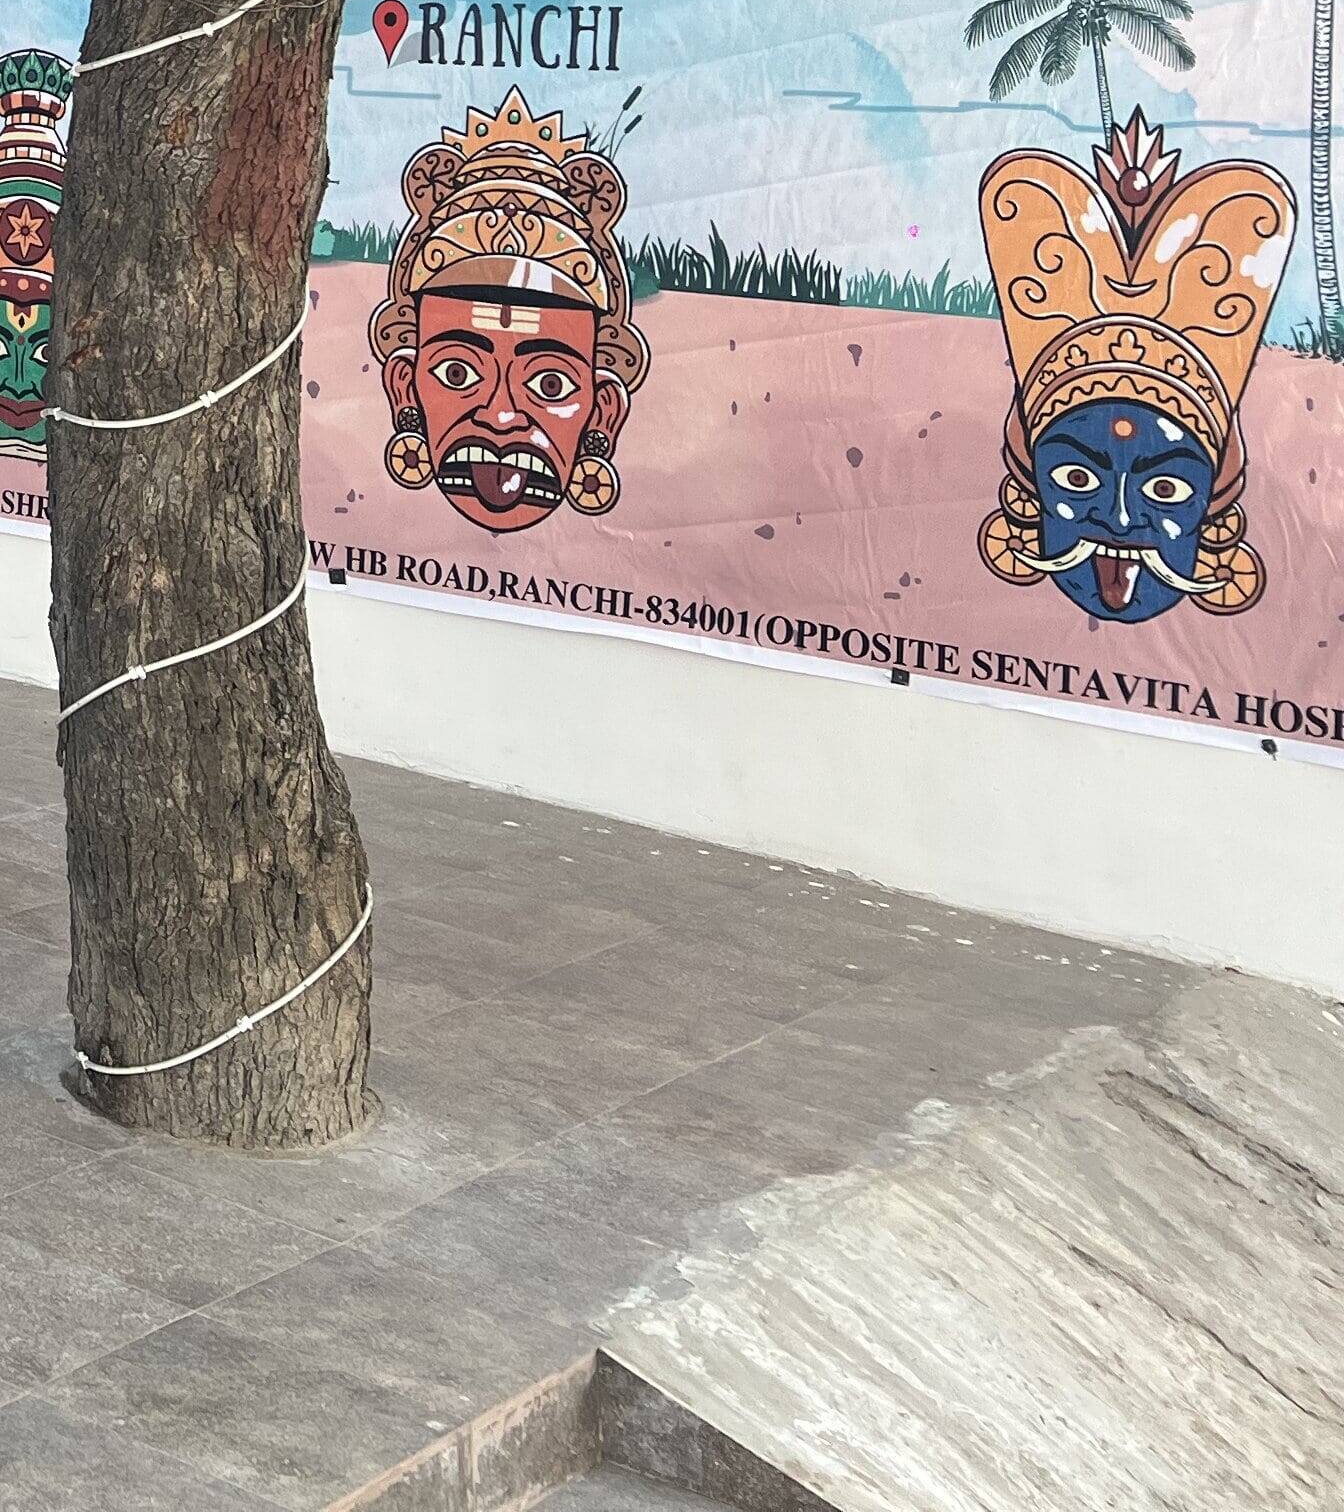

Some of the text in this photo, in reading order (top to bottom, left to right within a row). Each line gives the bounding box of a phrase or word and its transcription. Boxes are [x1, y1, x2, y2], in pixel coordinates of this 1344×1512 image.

[418, 1, 623, 71] RANCHI
[345, 544, 388, 577] HB
[970, 648, 1222, 721] SENTAVITA
